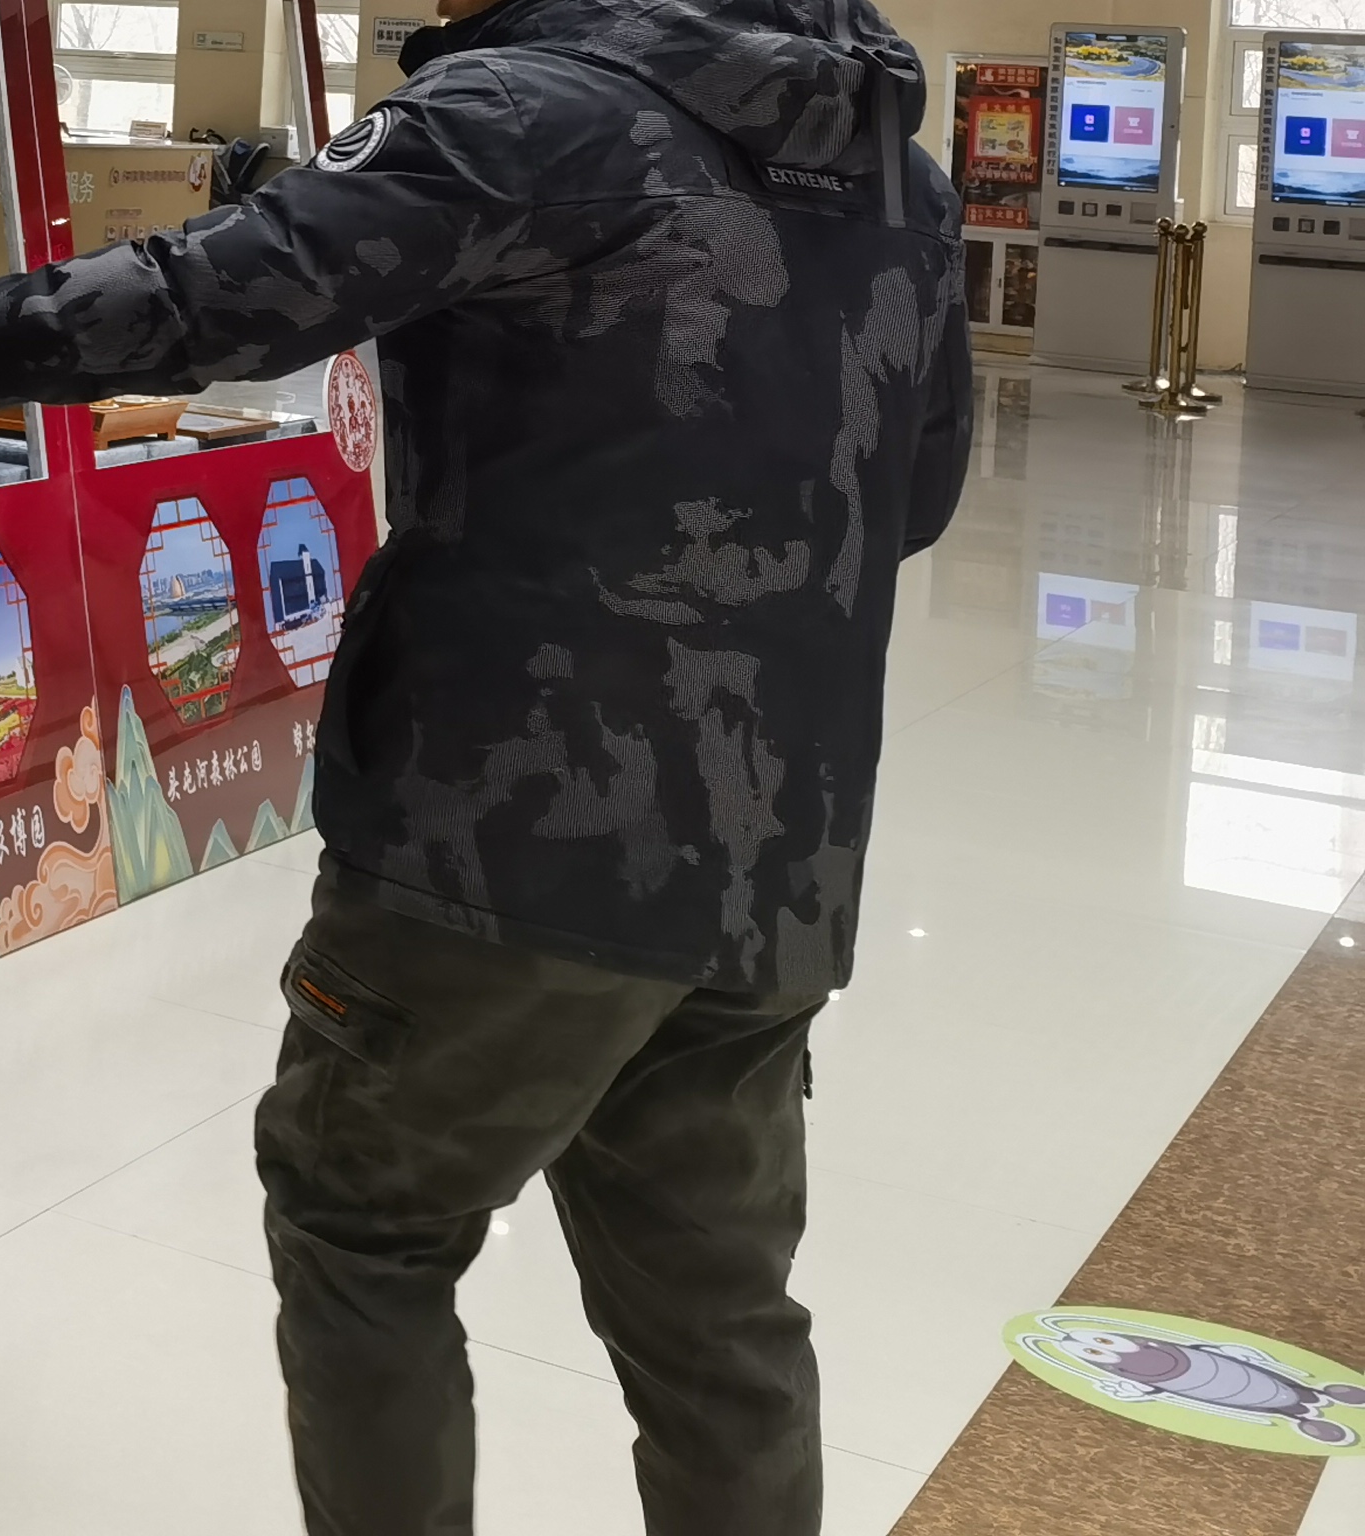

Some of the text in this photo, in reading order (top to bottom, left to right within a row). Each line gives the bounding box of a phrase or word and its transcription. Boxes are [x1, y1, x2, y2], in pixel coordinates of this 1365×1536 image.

[766, 166, 844, 193] EXTREME
[167, 739, 263, 803] 头屯河森林公园
